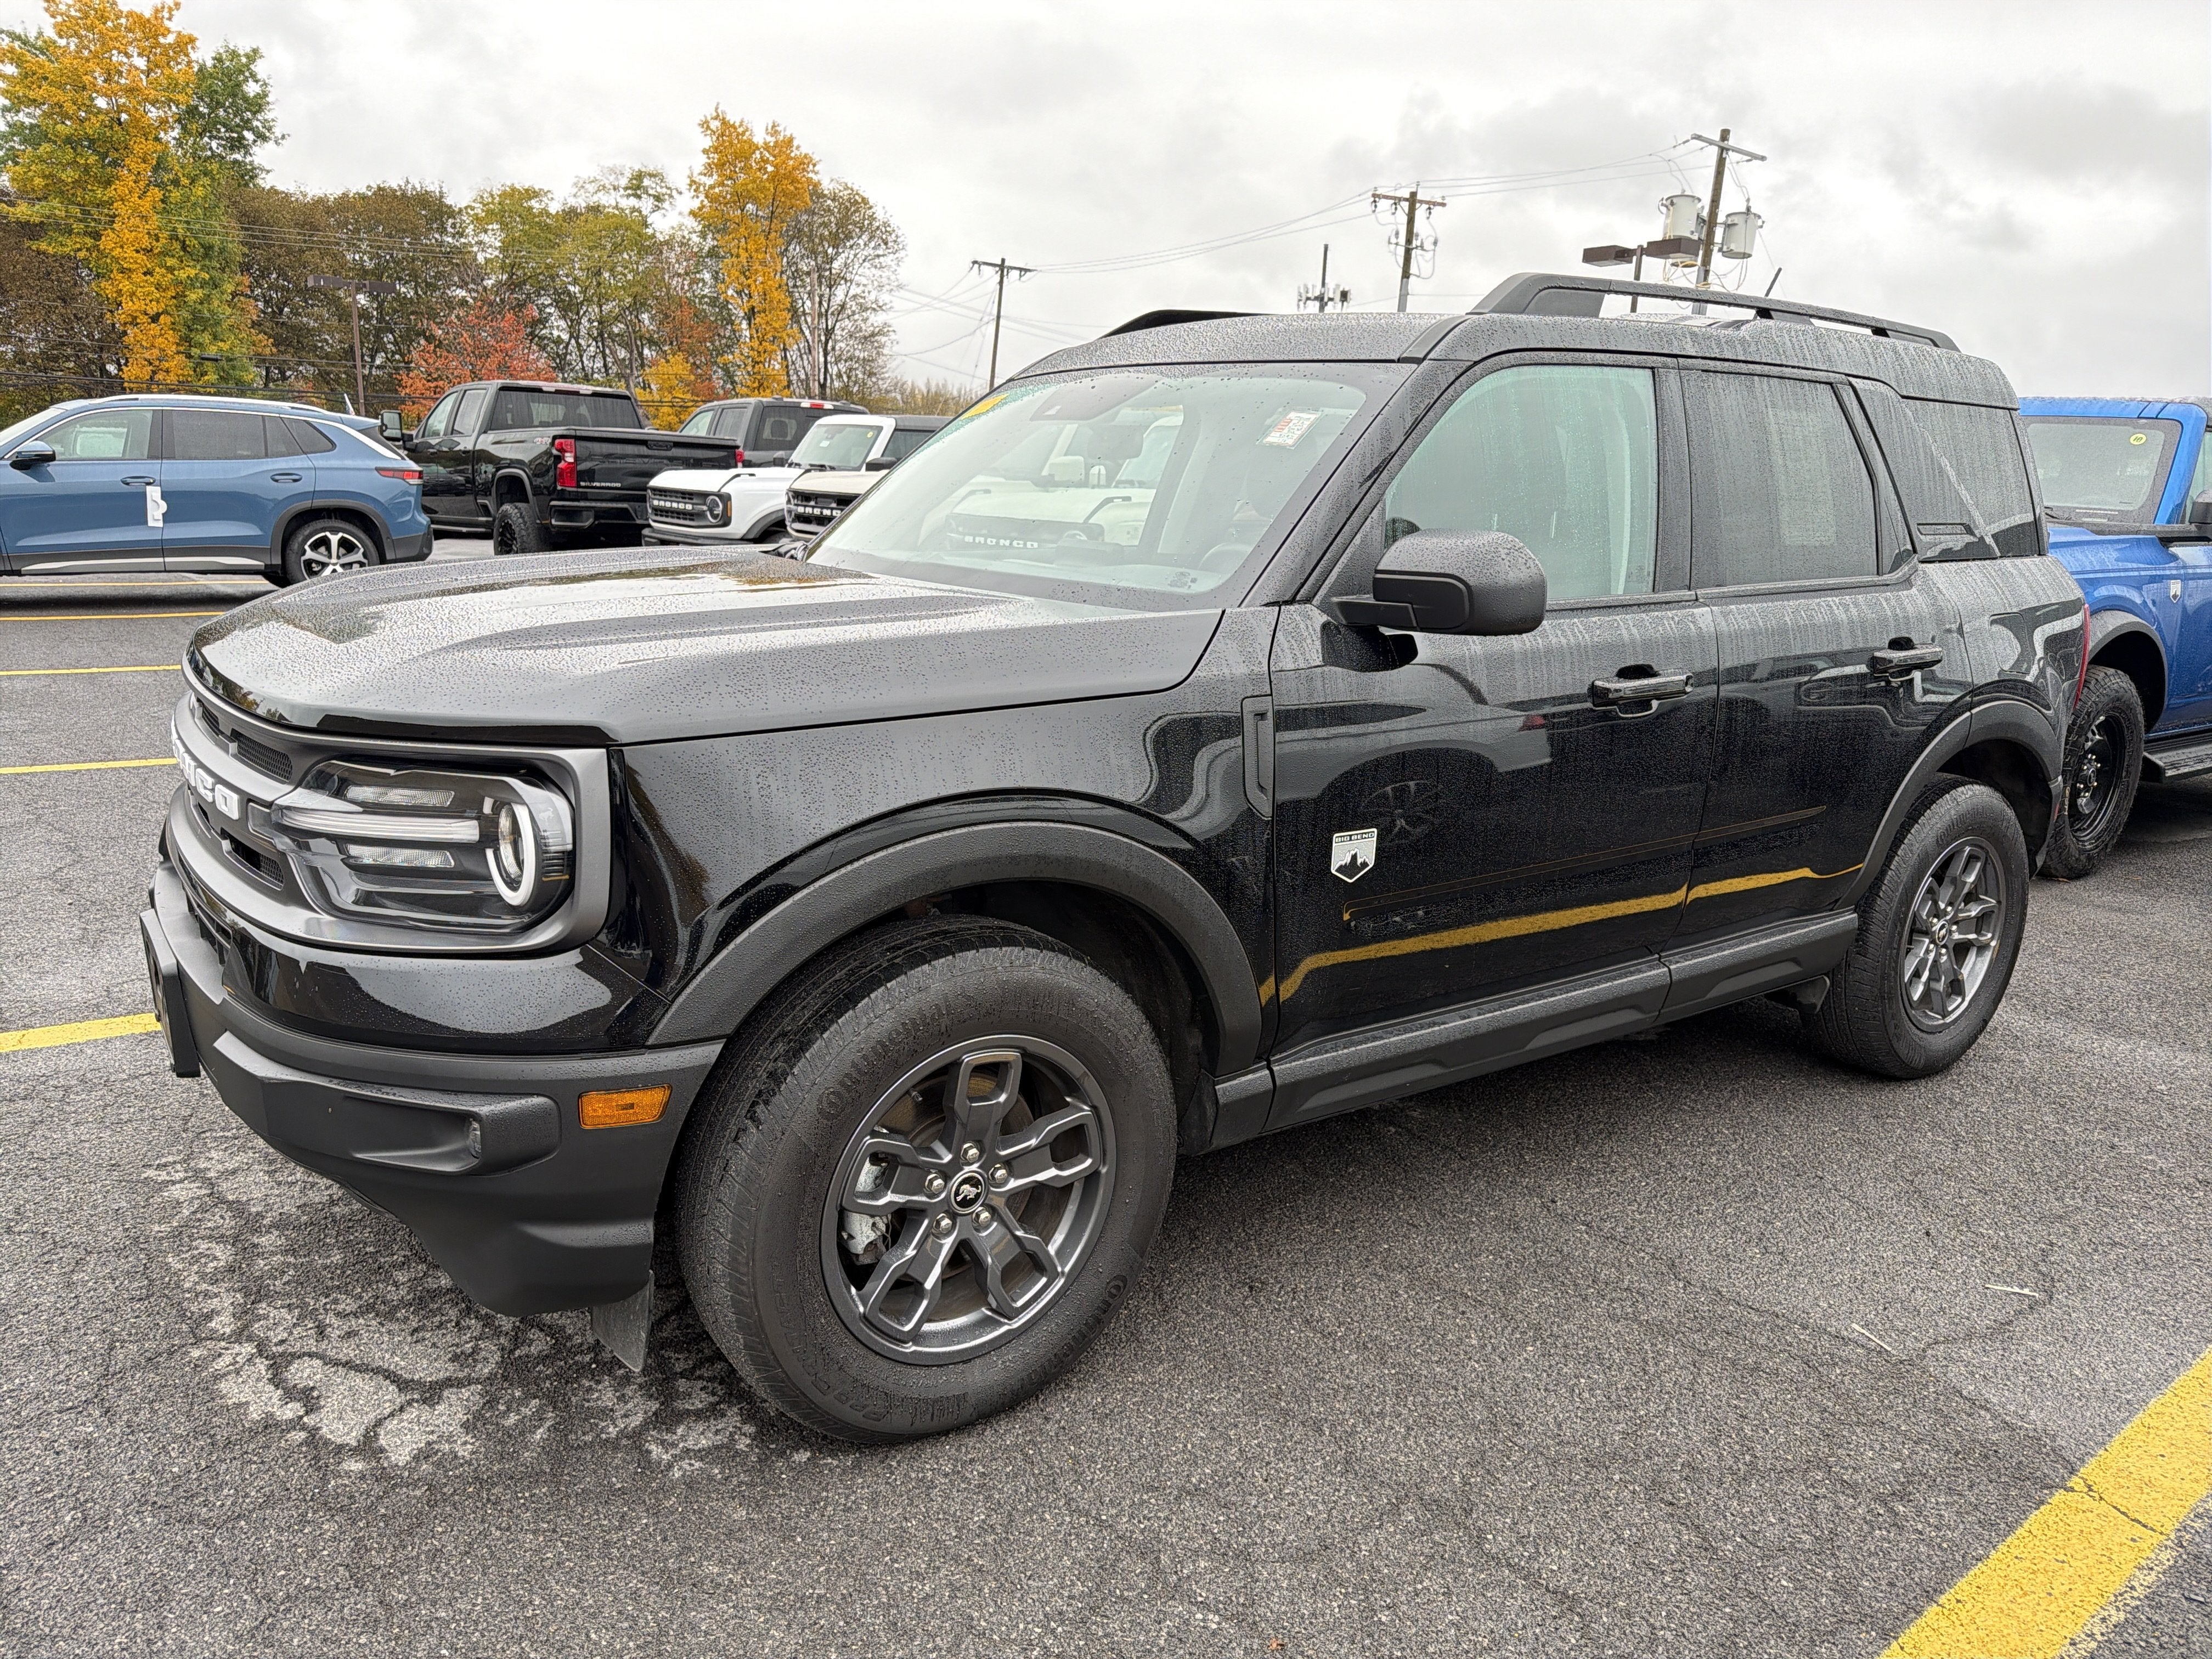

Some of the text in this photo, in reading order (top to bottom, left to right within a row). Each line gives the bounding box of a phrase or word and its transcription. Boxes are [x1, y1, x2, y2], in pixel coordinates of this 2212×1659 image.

[653, 499, 693, 510] BRONCO
[797, 506, 842, 517] BRONC
[964, 535, 1039, 549] BRONCO
[1351, 832, 1375, 840] BEND
